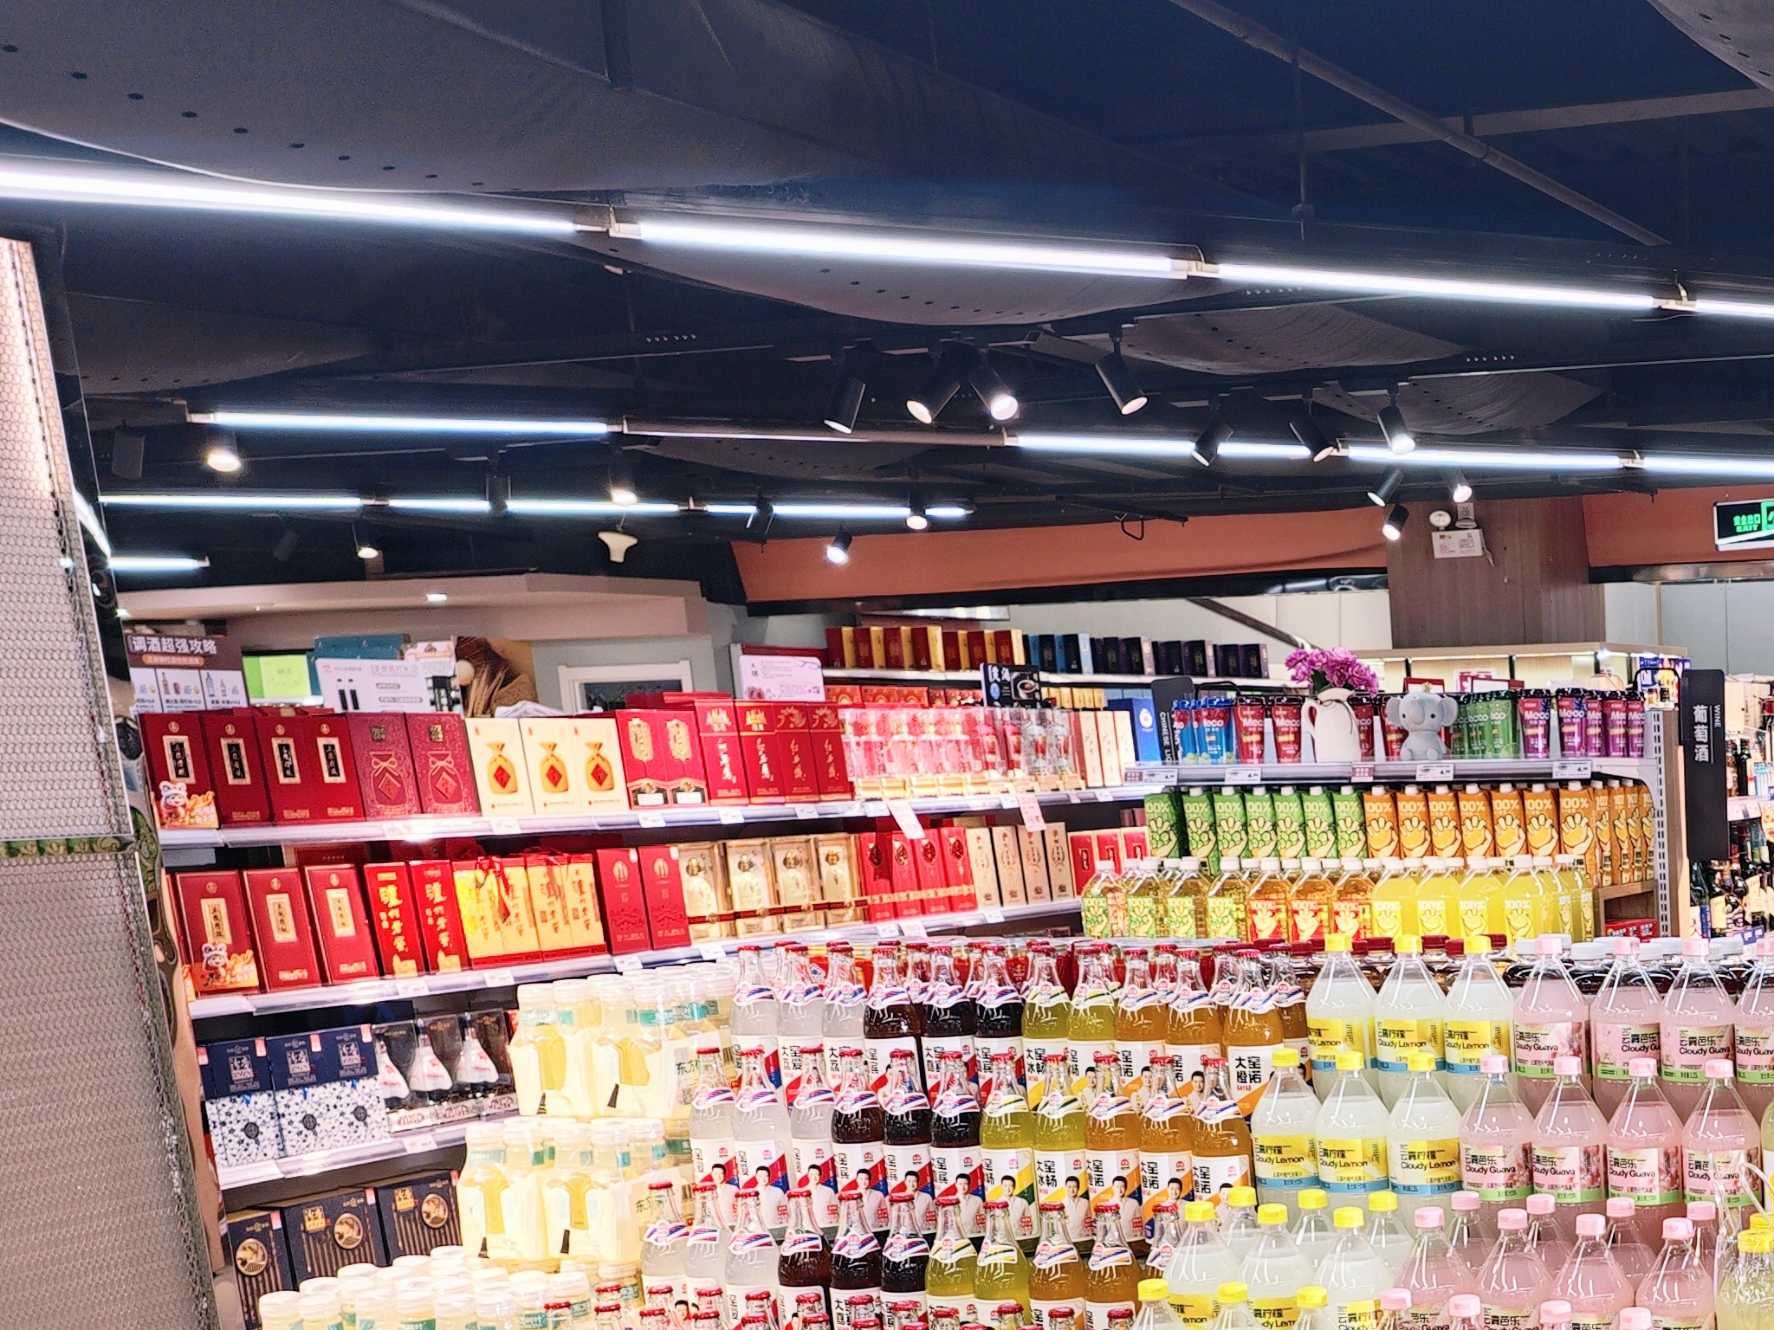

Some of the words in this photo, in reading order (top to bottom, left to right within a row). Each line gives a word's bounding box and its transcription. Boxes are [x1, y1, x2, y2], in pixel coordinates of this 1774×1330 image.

[1621, 1045, 1649, 1053] Cloudy
[1680, 1046, 1707, 1055] Cloudy
[1429, 1159, 1460, 1167] Lemon
[1490, 1165, 1516, 1173] Guava
[1630, 1169, 1656, 1177] Guava
